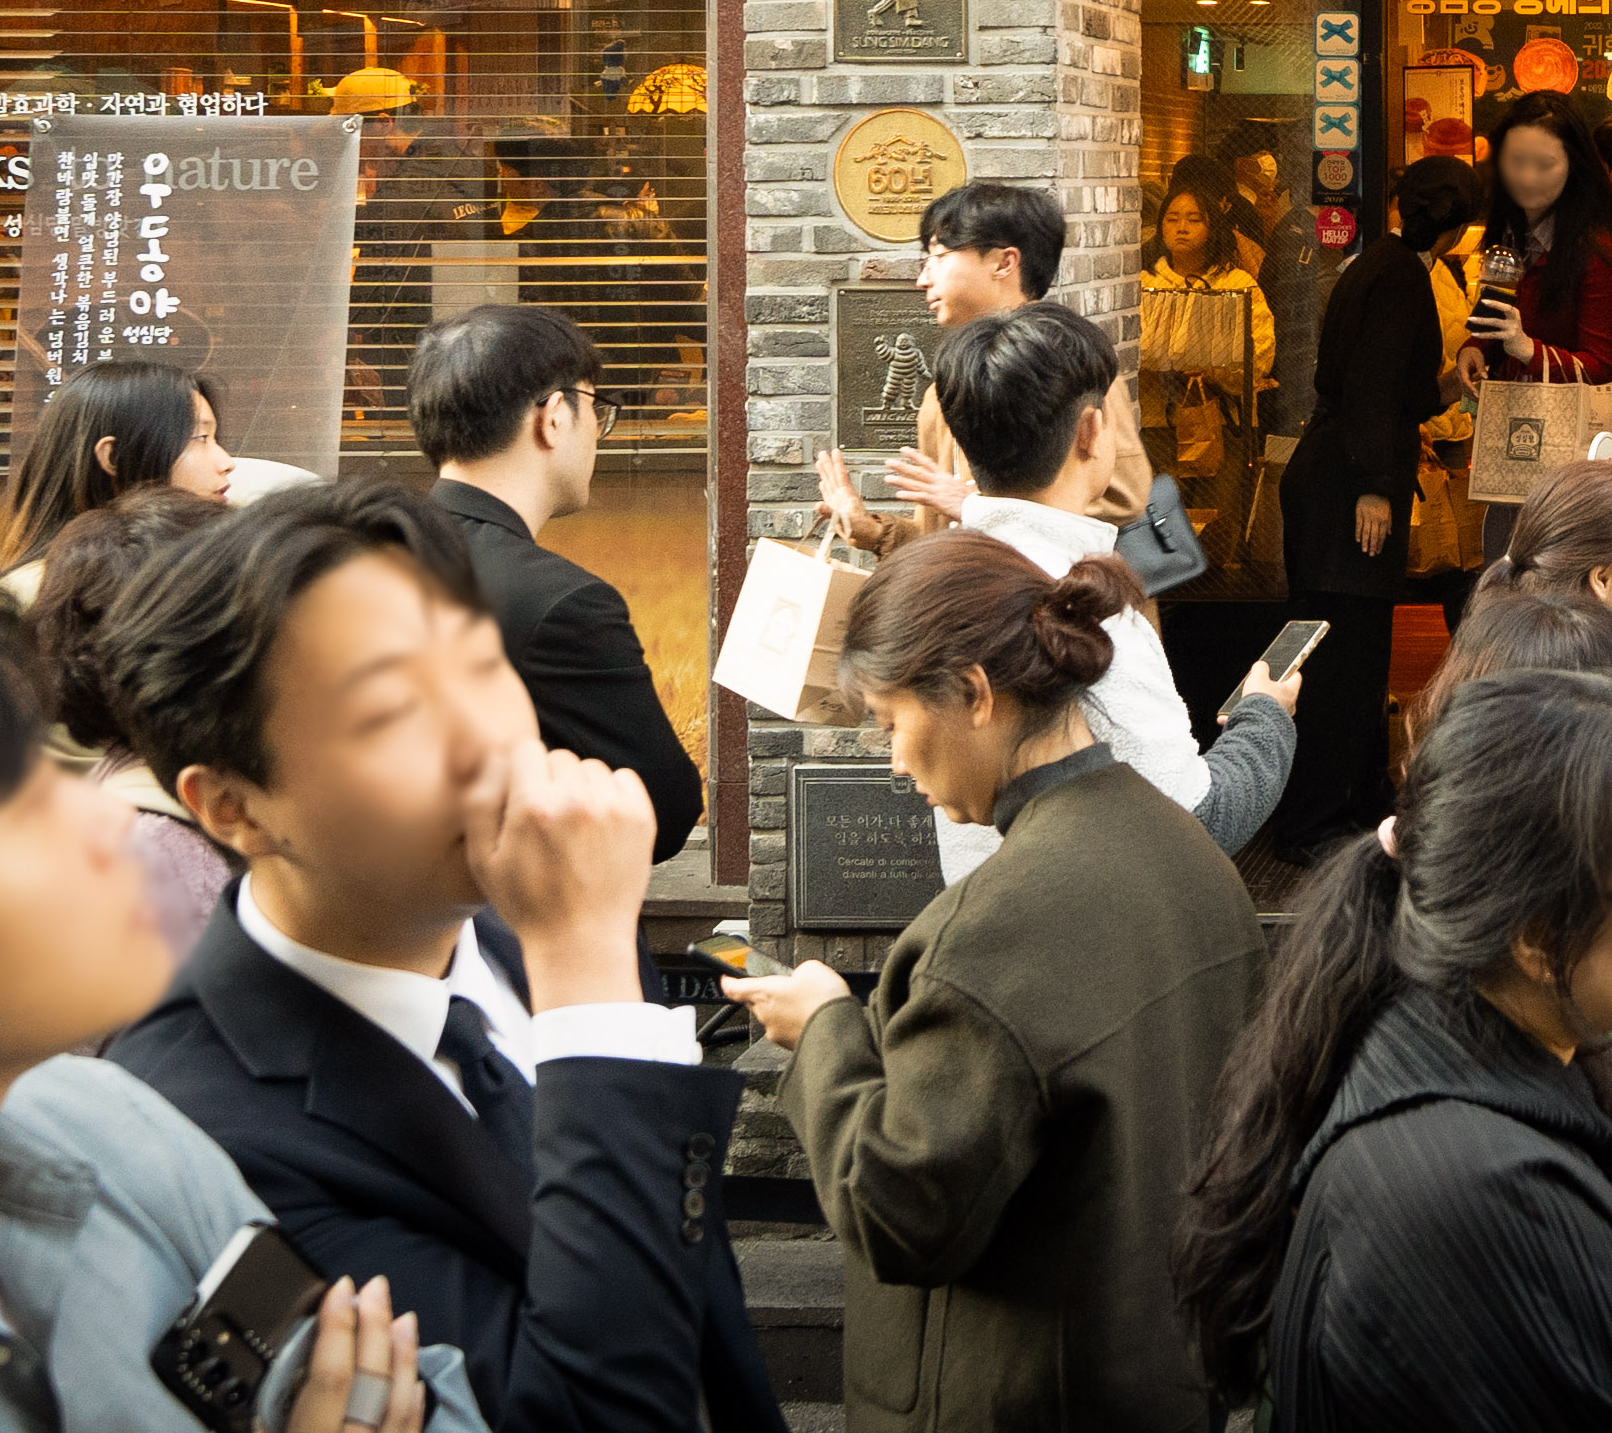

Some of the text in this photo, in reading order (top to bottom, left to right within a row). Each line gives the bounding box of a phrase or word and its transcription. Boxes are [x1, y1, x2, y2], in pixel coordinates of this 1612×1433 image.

[100, 92, 170, 116] 자연과
[177, 92, 268, 117] 협업하다
[129, 152, 181, 319] 우동야
[123, 325, 173, 345] 성심당
